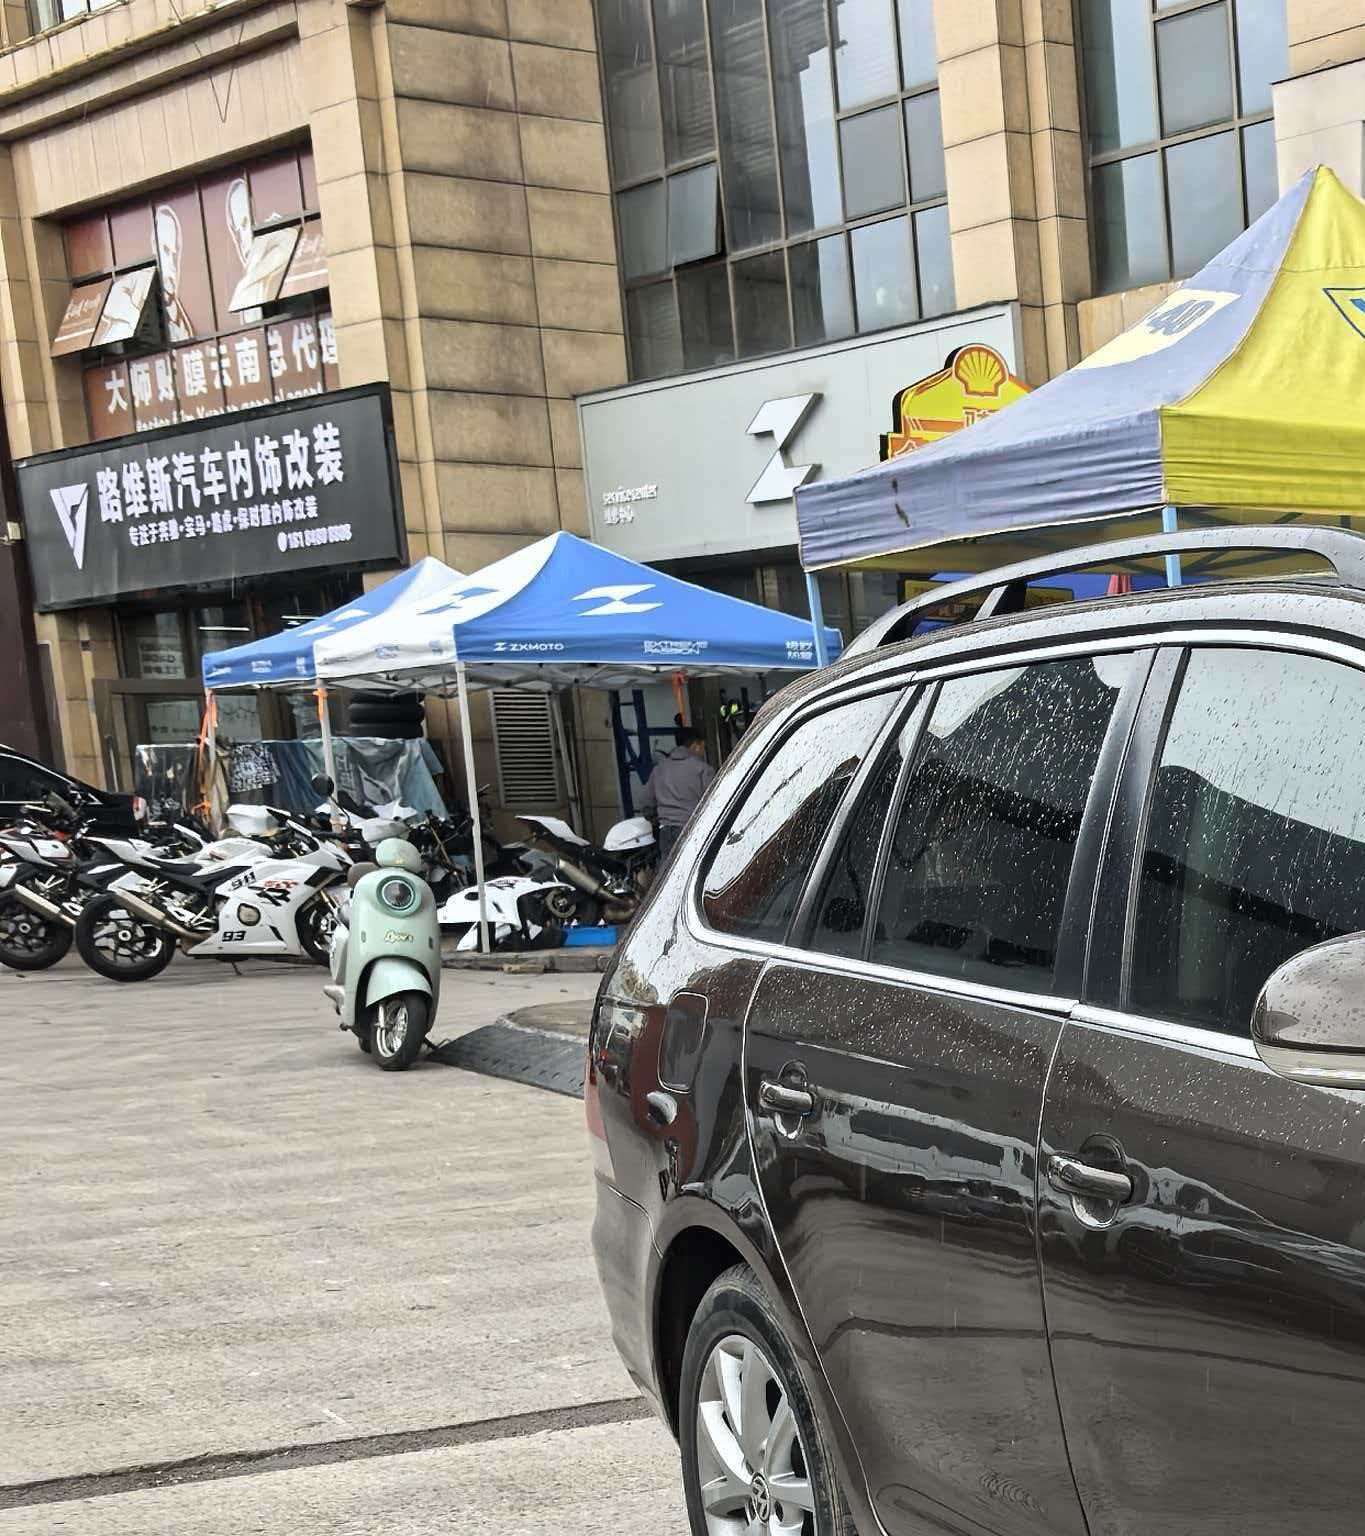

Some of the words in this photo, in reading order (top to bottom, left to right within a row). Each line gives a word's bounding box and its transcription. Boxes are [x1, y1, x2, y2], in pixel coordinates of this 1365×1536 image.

[96, 422, 344, 523] 路维斯汽车内饰改装
[222, 930, 246, 942] 93
